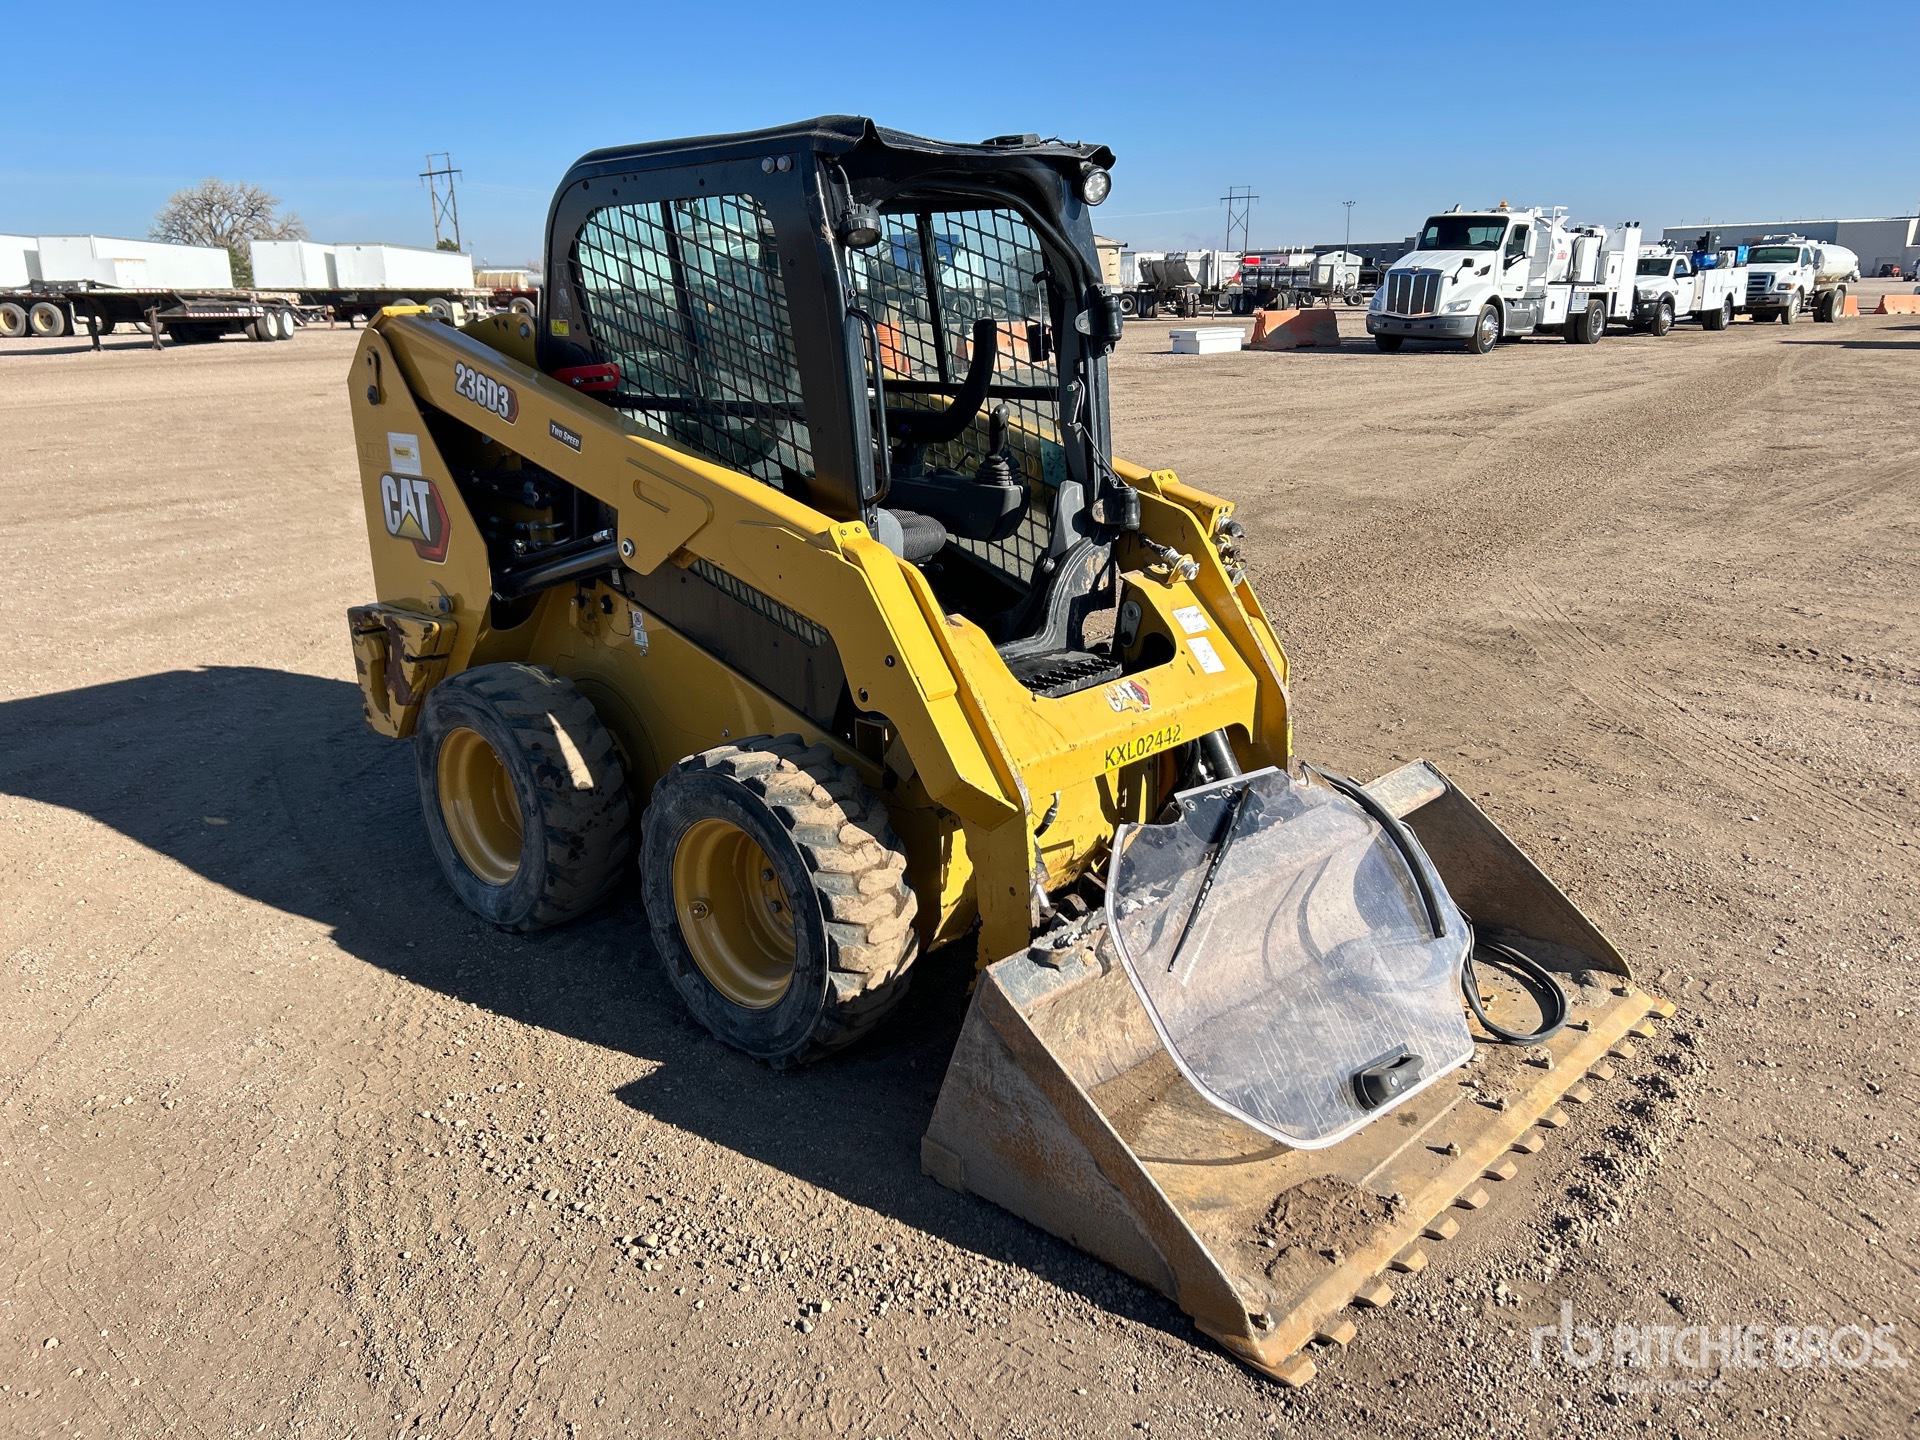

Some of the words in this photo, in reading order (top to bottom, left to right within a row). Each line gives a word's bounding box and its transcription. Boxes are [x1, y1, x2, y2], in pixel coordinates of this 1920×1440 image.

[749, 335, 774, 355] CAT
[455, 362, 509, 418] 236D3
[380, 474, 431, 542] CAT
[1105, 724, 1181, 769] KXL02442
